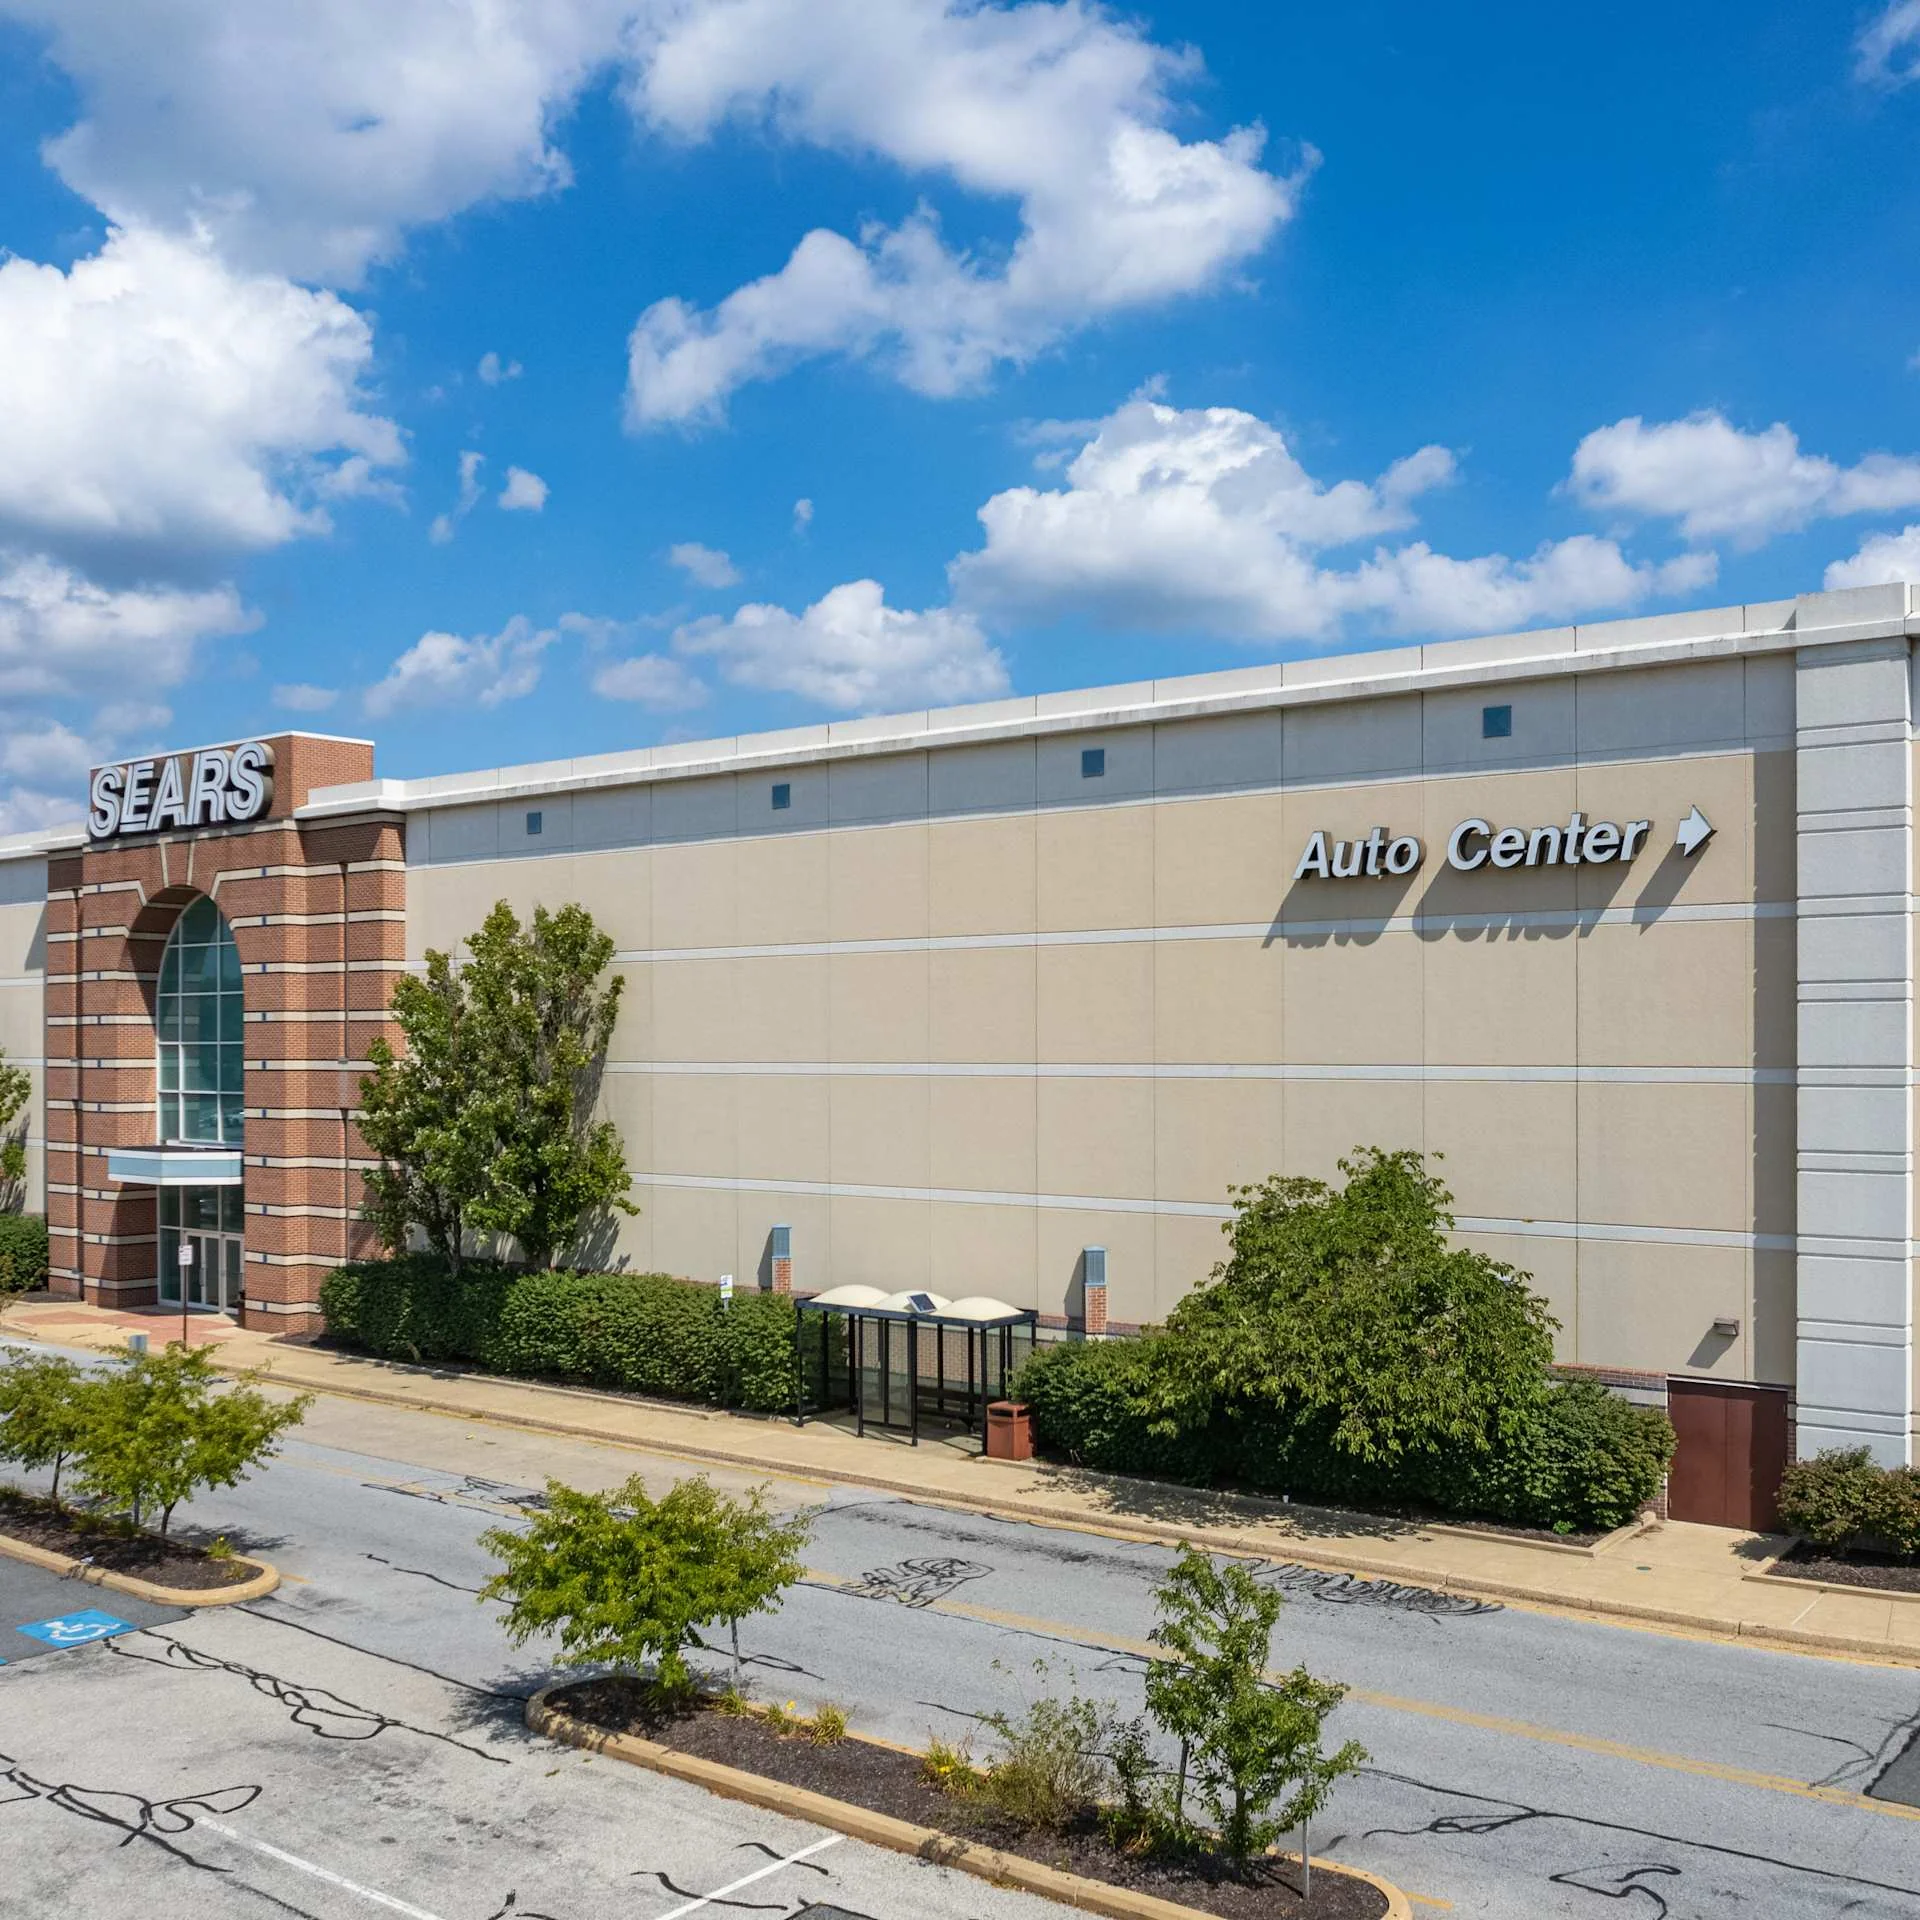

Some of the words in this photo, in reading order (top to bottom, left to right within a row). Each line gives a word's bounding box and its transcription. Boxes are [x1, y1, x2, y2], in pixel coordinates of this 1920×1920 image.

[89, 742, 273, 837] SEARS
[1293, 826, 1424, 879] Auto
[1447, 812, 1651, 871] Center
